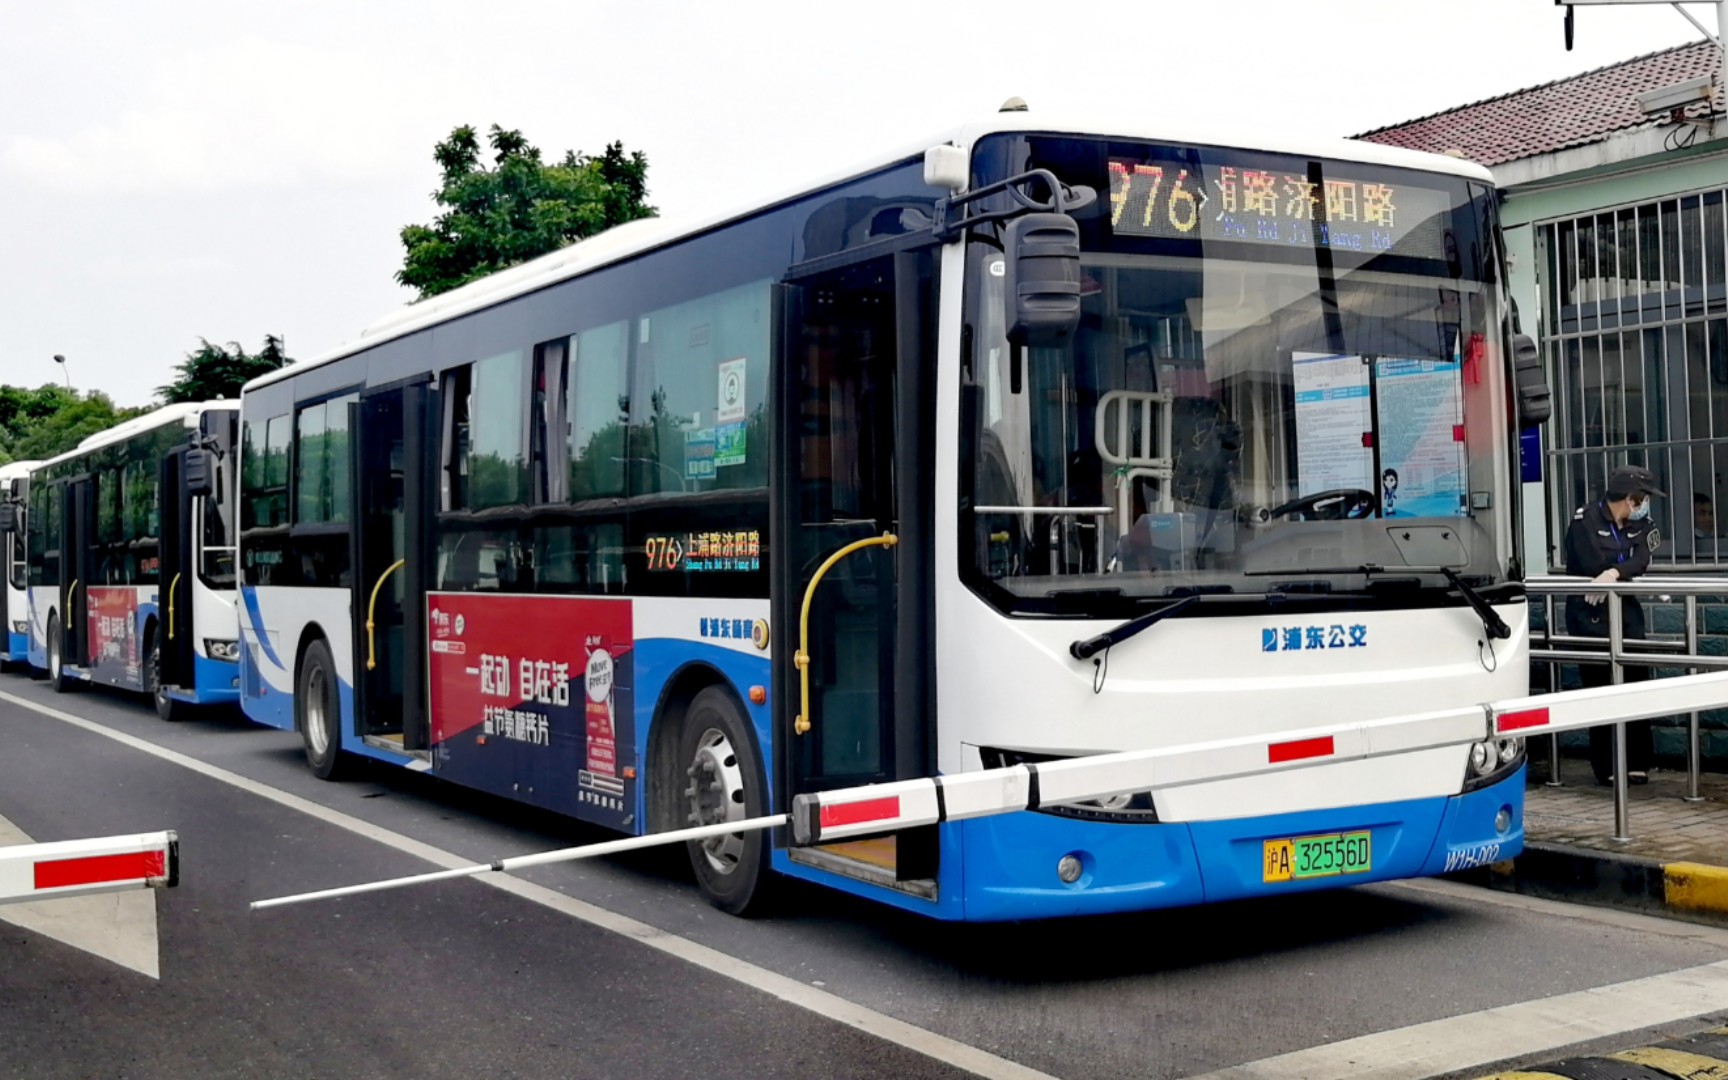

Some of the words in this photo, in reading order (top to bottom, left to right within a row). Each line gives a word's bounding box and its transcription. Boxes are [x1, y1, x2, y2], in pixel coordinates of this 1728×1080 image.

[646, 537, 677, 569] 976
[1282, 624, 1367, 650] 浦东公交
[466, 653, 510, 697] 一起动
[520, 657, 569, 706] 自在活
[1267, 846, 1290, 875] 沪A
[1300, 838, 1369, 871] 32556D
[1443, 845, 1500, 873] W1H-002
